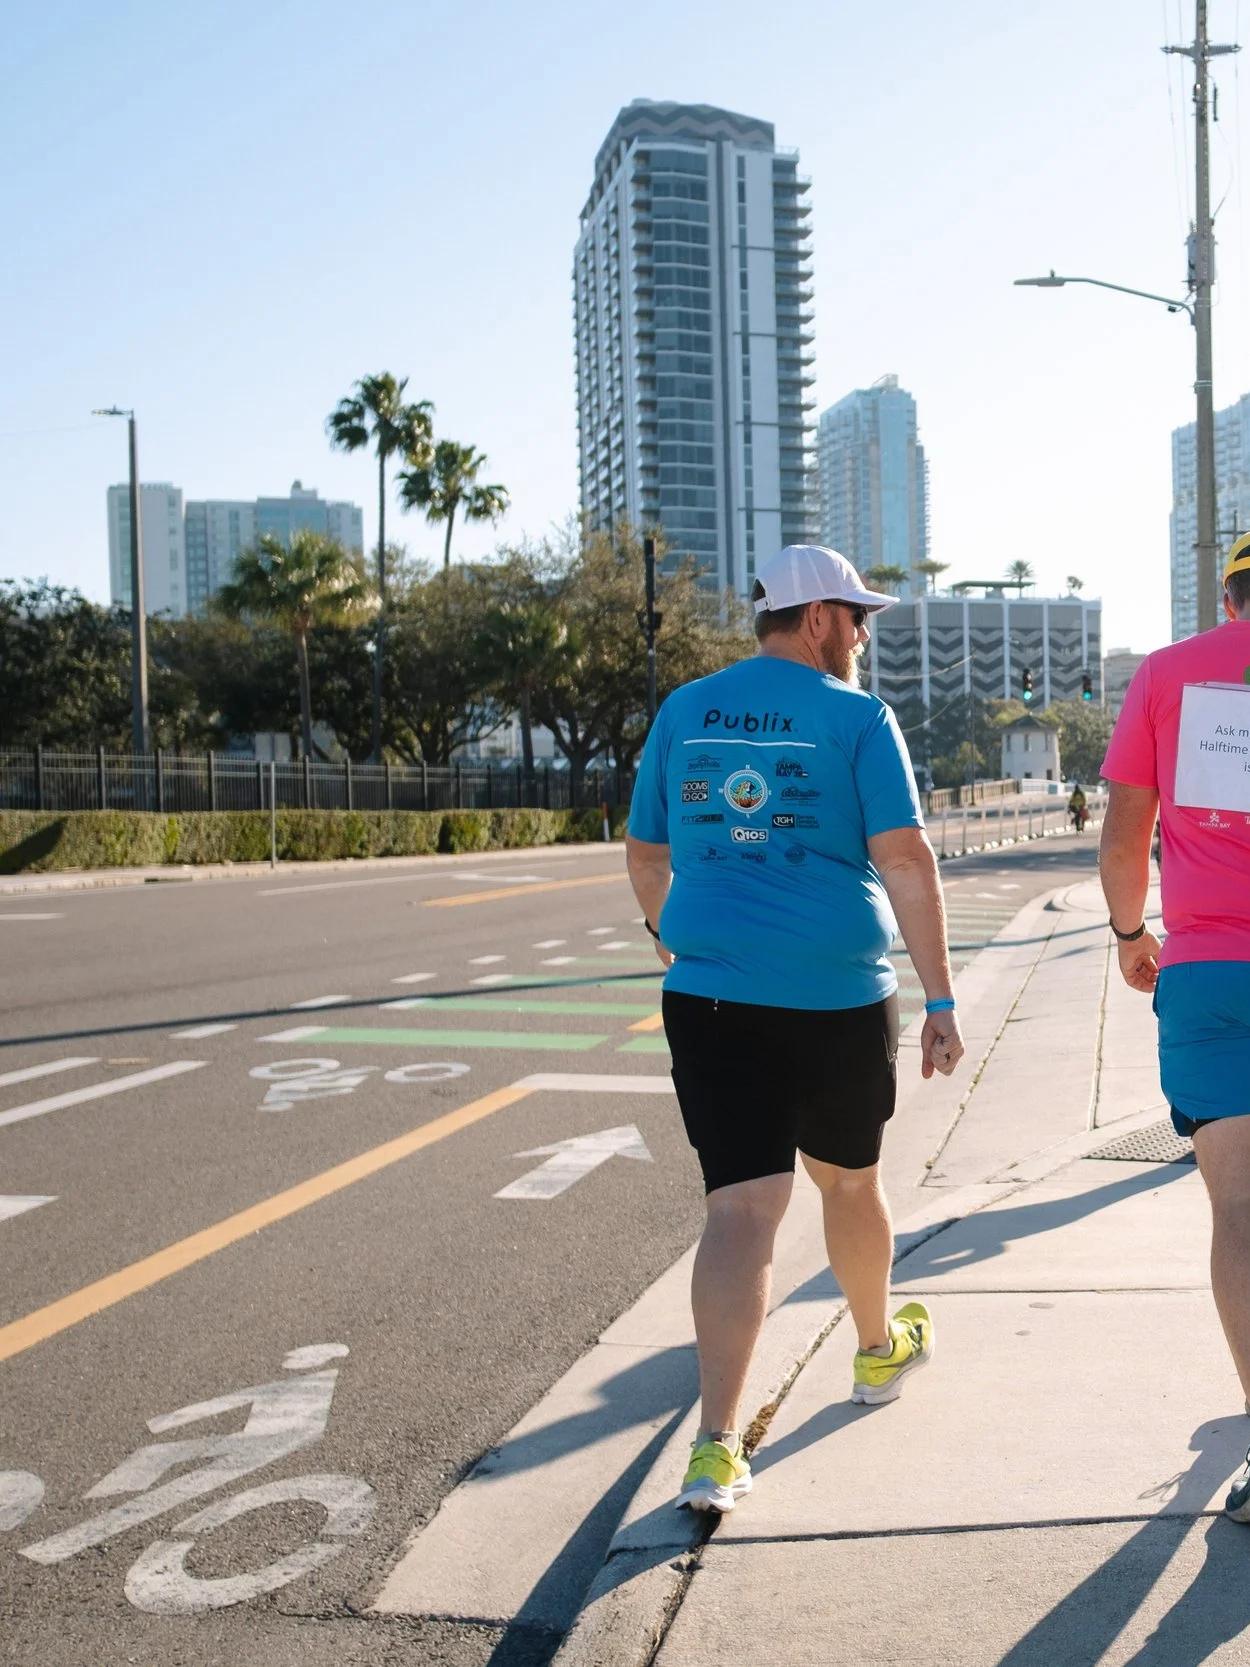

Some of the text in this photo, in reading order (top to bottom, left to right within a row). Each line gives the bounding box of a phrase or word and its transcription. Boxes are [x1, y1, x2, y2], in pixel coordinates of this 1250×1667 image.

[703, 709, 793, 733] Publix
[1215, 725, 1235, 737] Ask
[1200, 739, 1248, 754] Halftime
[683, 781, 708, 790] ROOMS
[776, 816, 794, 824] TGH
[734, 828, 766, 842] Q105
